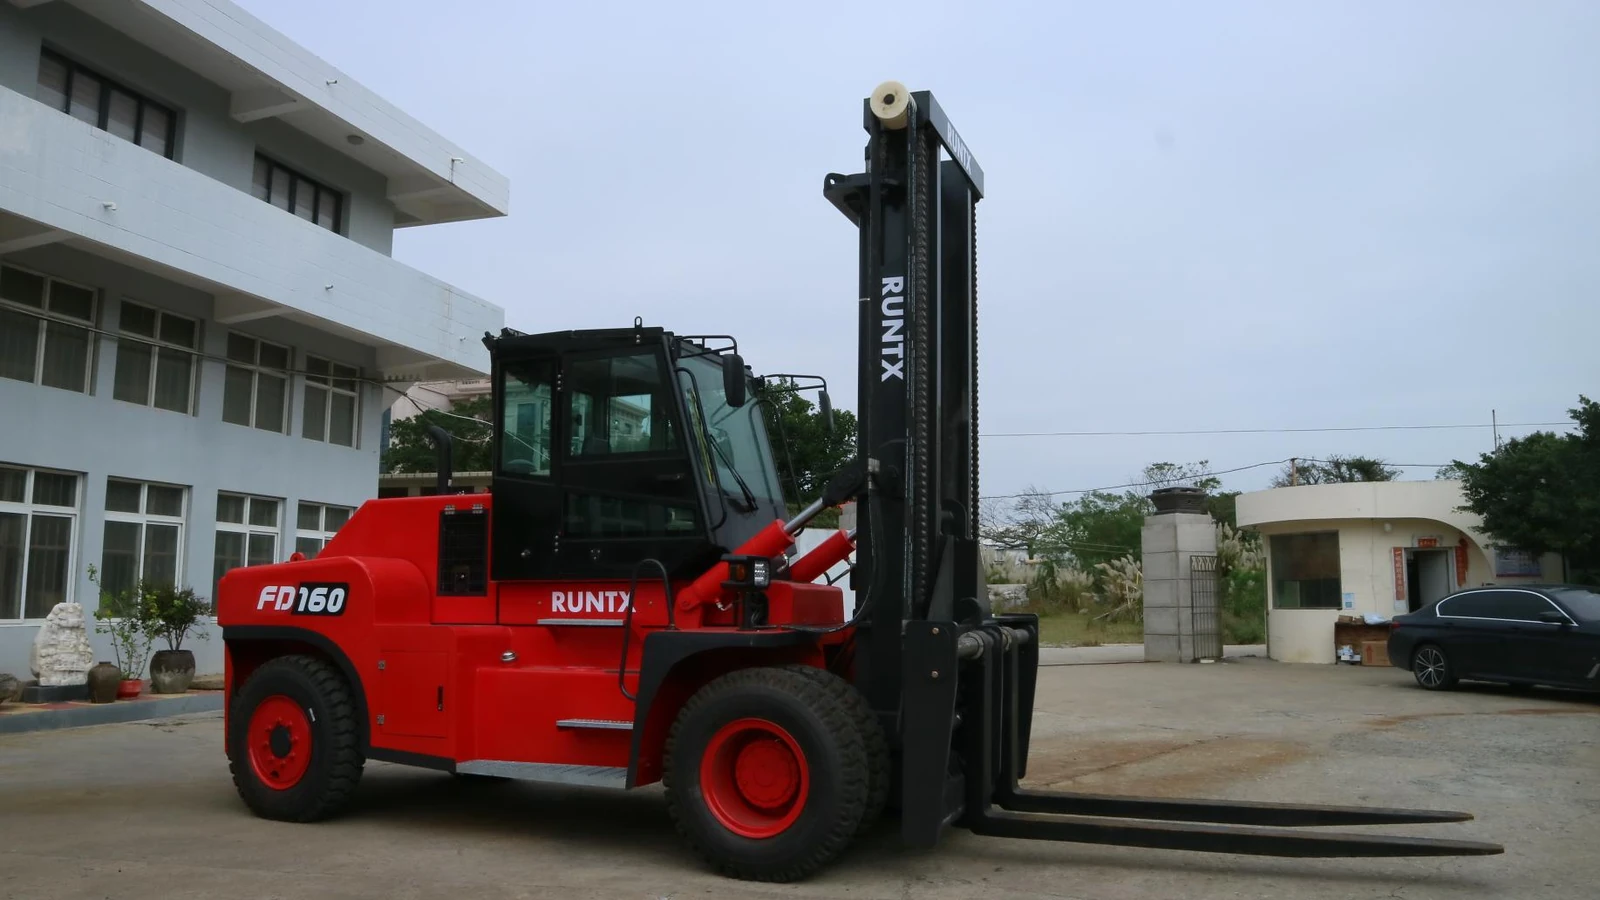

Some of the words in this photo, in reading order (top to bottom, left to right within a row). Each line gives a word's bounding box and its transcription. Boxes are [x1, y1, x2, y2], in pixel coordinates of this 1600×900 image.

[947, 122, 972, 174] RUNTX
[881, 276, 904, 383] RUNTX
[256, 585, 346, 613] FD160
[551, 591, 637, 613] RUNTX
